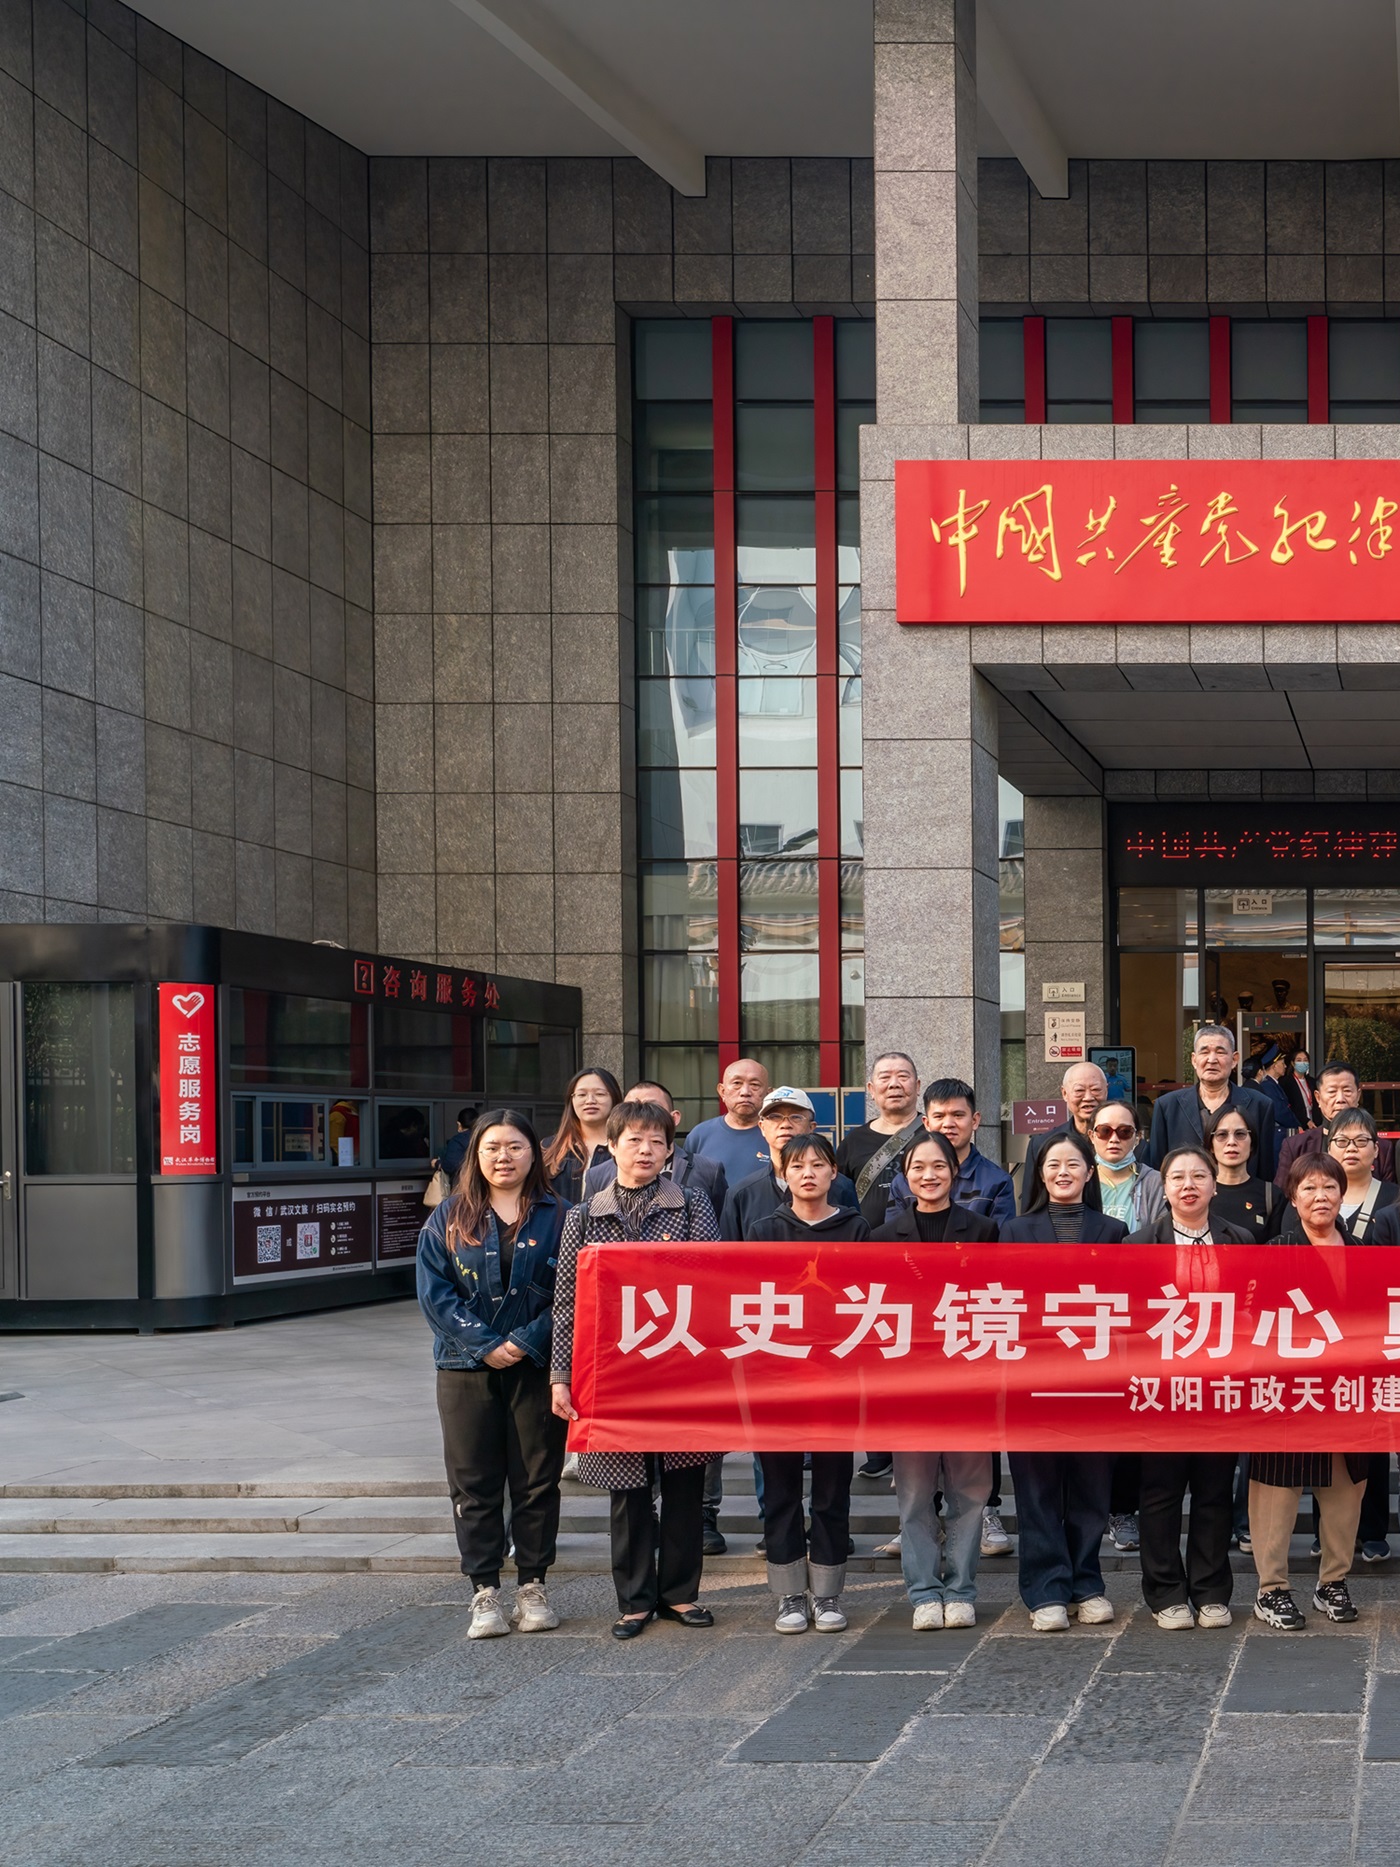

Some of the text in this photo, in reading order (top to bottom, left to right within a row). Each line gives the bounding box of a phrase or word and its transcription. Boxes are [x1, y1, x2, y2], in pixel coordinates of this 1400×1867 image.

[382, 964, 501, 1010] 咨询服务处
[178, 1032, 201, 1144] 志愿服务岗
[1024, 1105, 1056, 1116] 入口
[616, 1281, 1344, 1361] 以史为镜守初心
